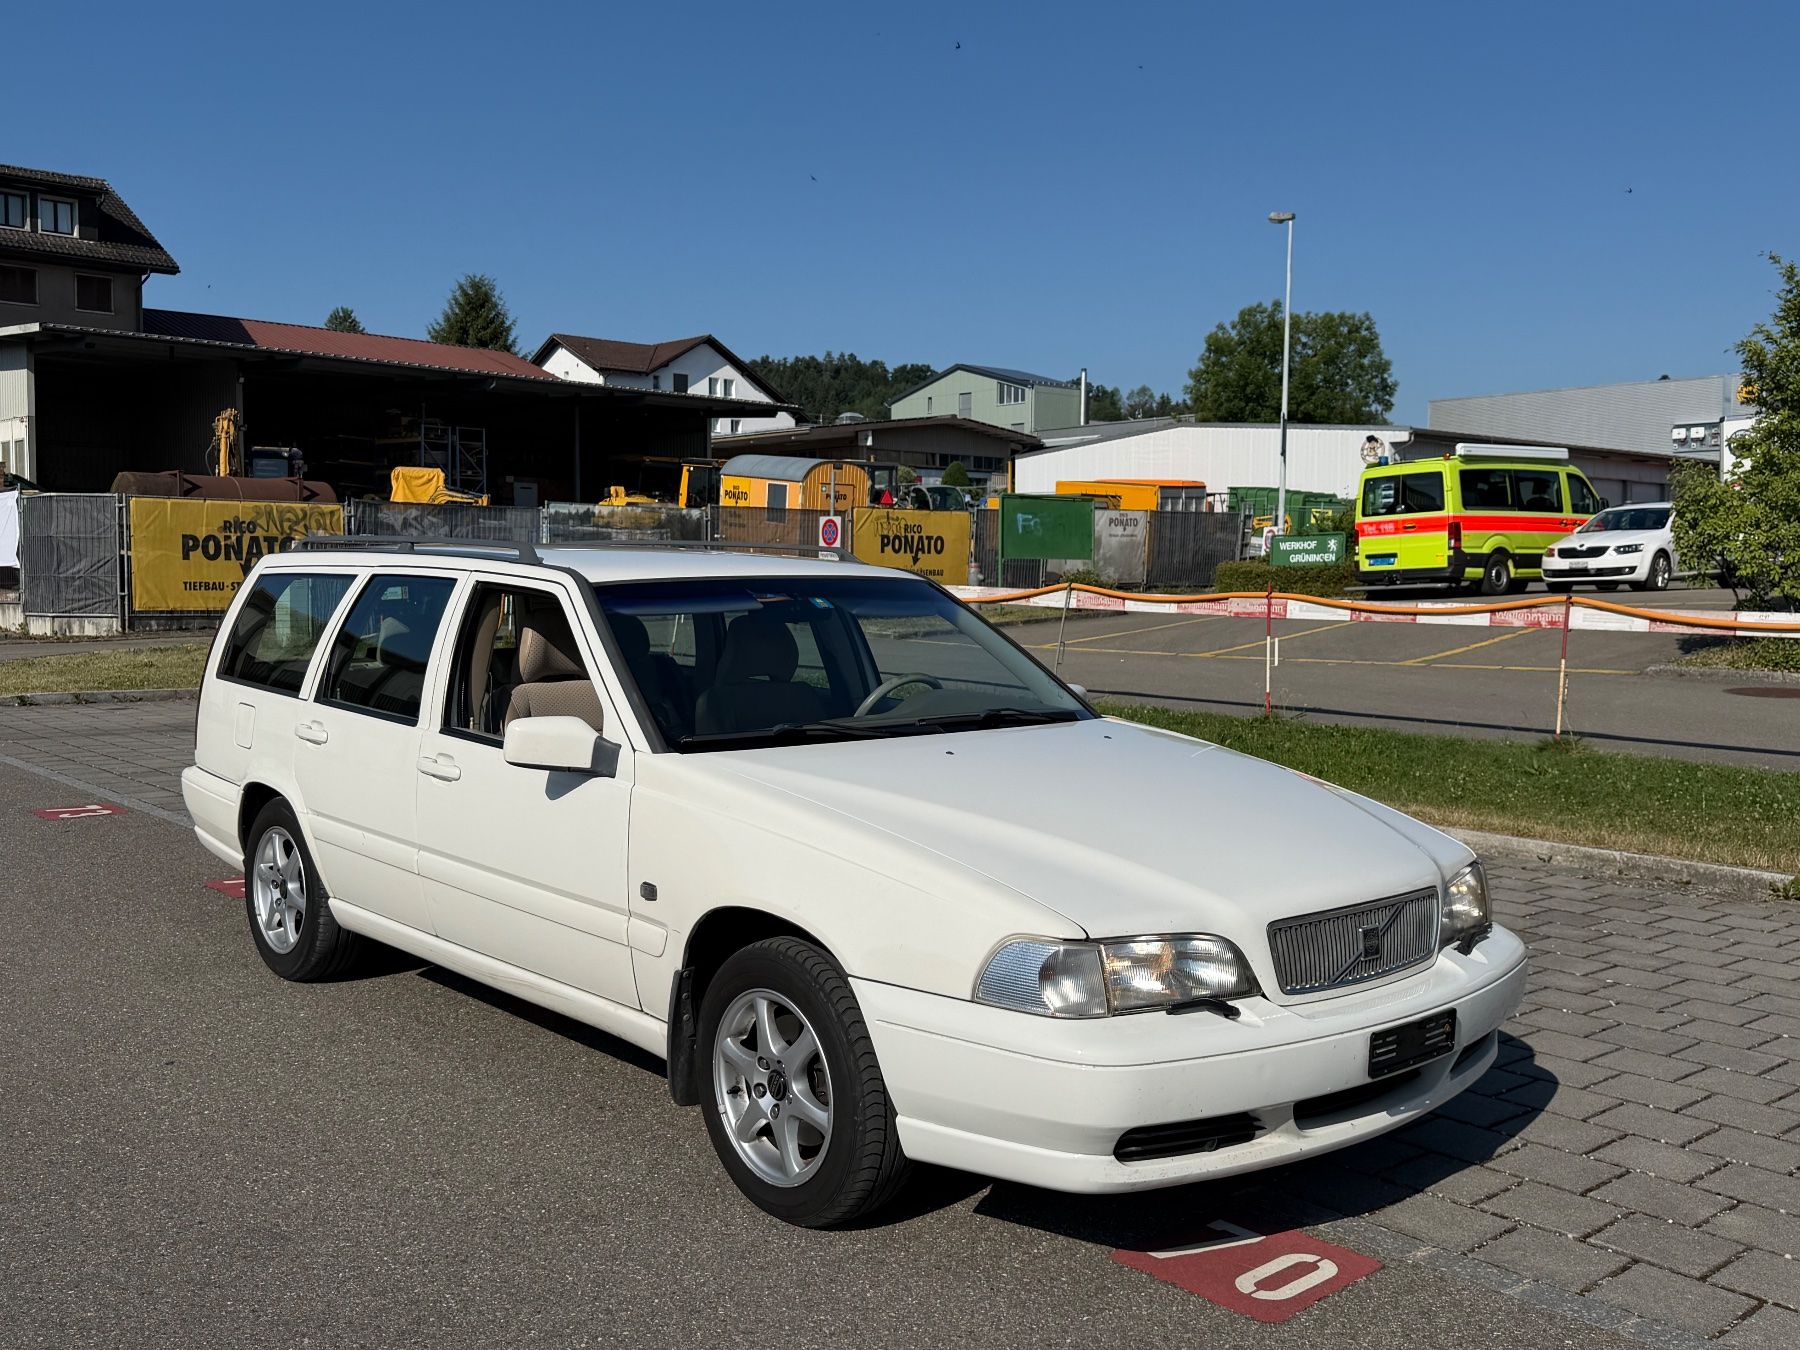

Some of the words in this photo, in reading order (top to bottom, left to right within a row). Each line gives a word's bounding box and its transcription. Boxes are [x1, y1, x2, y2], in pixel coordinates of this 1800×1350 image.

[725, 489, 748, 501] PONATO
[223, 520, 257, 534] RICO
[1108, 517, 1138, 527] PONATO
[904, 524, 922, 534] RICO
[880, 534, 944, 555] PONATO
[1279, 541, 1317, 551] WERKHOF
[1289, 553, 1336, 563] GRÜNINGEN
[1147, 1219, 1339, 1301] 10
